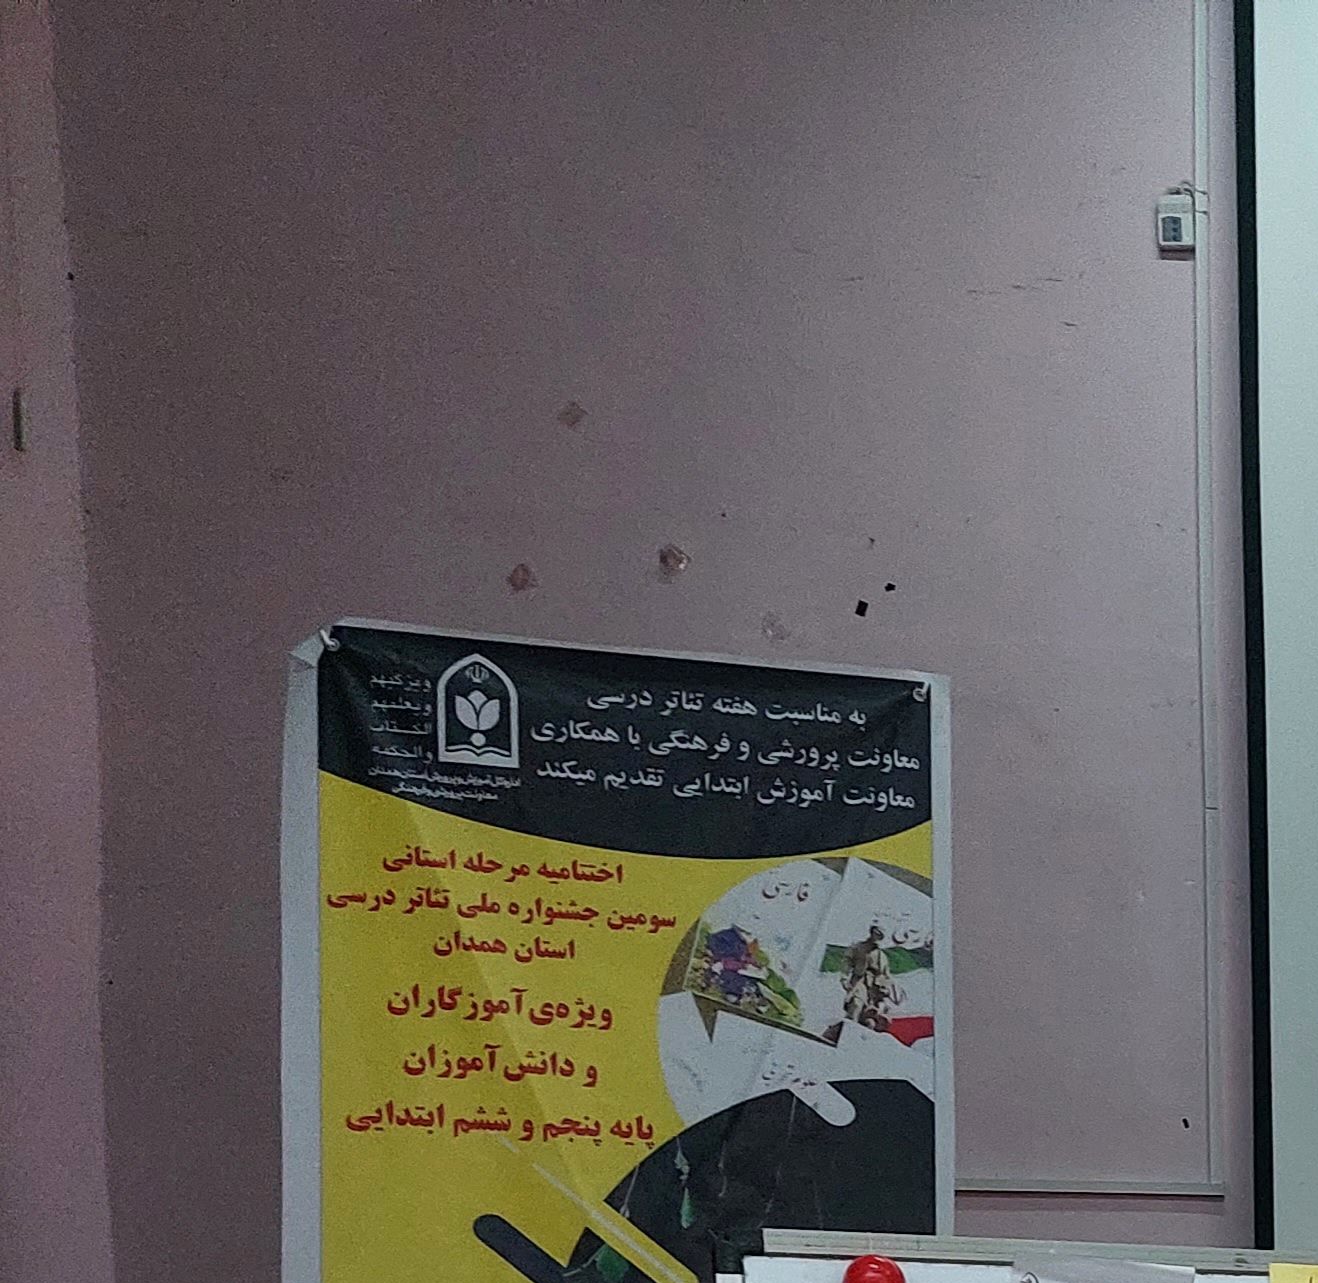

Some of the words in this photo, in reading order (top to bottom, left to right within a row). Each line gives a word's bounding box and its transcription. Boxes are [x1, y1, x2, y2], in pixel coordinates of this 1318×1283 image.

[586, 689, 653, 711] درسی
[661, 690, 704, 716] تئاتر
[712, 697, 758, 716] هفته
[764, 701, 842, 726] مناسبت
[530, 719, 620, 744] همکاری
[849, 707, 867, 730] به
[627, 724, 641, 748] با
[647, 730, 731, 761] فرهنگی
[739, 740, 751, 761] و
[757, 739, 841, 772] پرورشی
[847, 747, 921, 774] معاونت
[536, 760, 597, 787] میکند
[603, 767, 666, 791] تقدیم
[672, 773, 750, 800] ابتدایی
[756, 776, 838, 805] آموزش
[842, 787, 916, 813] معاونت
[383, 845, 456, 873] استانی
[464, 851, 530, 883] مرحله
[537, 860, 624, 885] اختتامیه
[326, 888, 397, 913] درسی
[402, 887, 450, 915] تئاتر
[456, 893, 501, 919] ملی
[508, 897, 600, 928] جشنواره
[606, 907, 677, 934] سومین
[433, 930, 508, 957] همدان
[514, 936, 577, 964] استان
[386, 983, 529, 1022] آموزگاران
[582, 1065, 599, 1088] و
[345, 1099, 445, 1135] ابتدایی
[452, 1106, 512, 1138] ششم
[517, 1118, 535, 1141] و
[542, 1116, 603, 1146] پنجم
[609, 1115, 656, 1148] پایه
